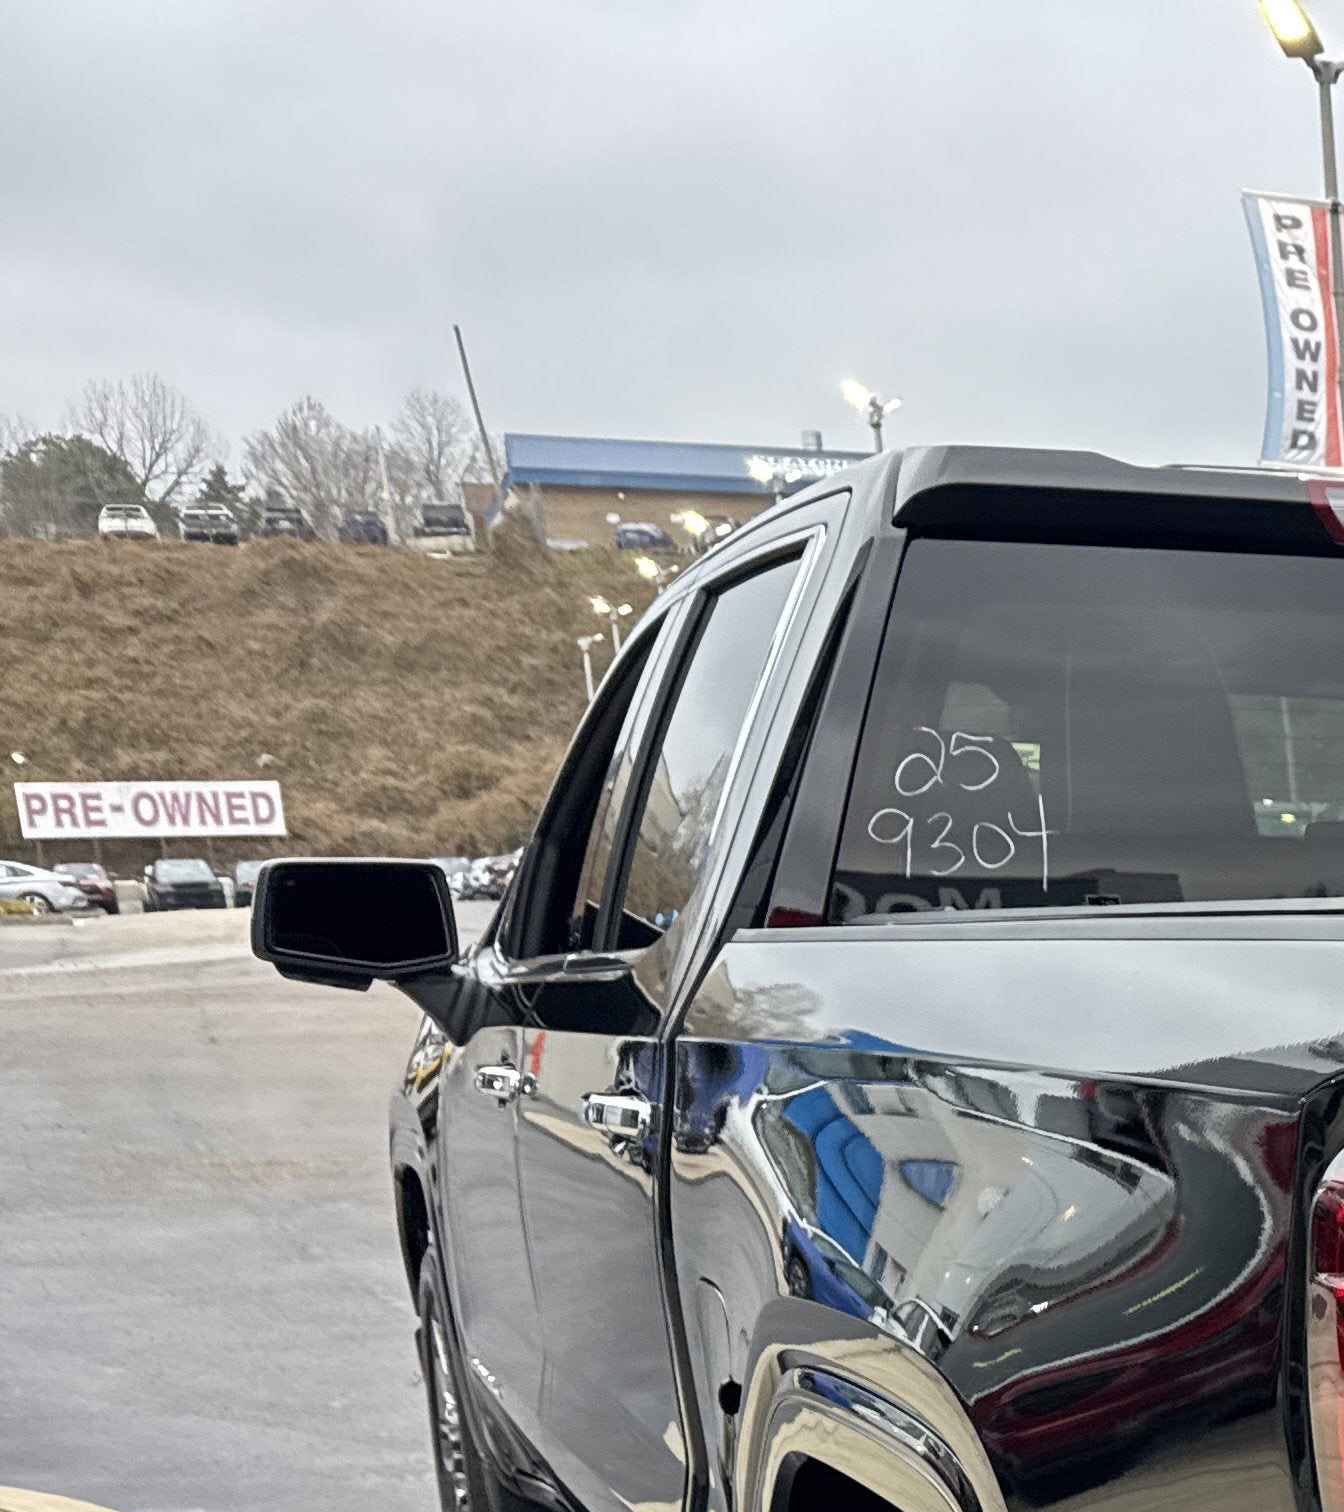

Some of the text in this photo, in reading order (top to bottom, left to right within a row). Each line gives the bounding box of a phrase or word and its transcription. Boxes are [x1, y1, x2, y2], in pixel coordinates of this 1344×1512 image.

[1272, 212, 1322, 451] PRE OWNED
[893, 725, 1000, 797] 25
[22, 790, 276, 829] PRE-OWNED
[867, 793, 1061, 893] 9304
